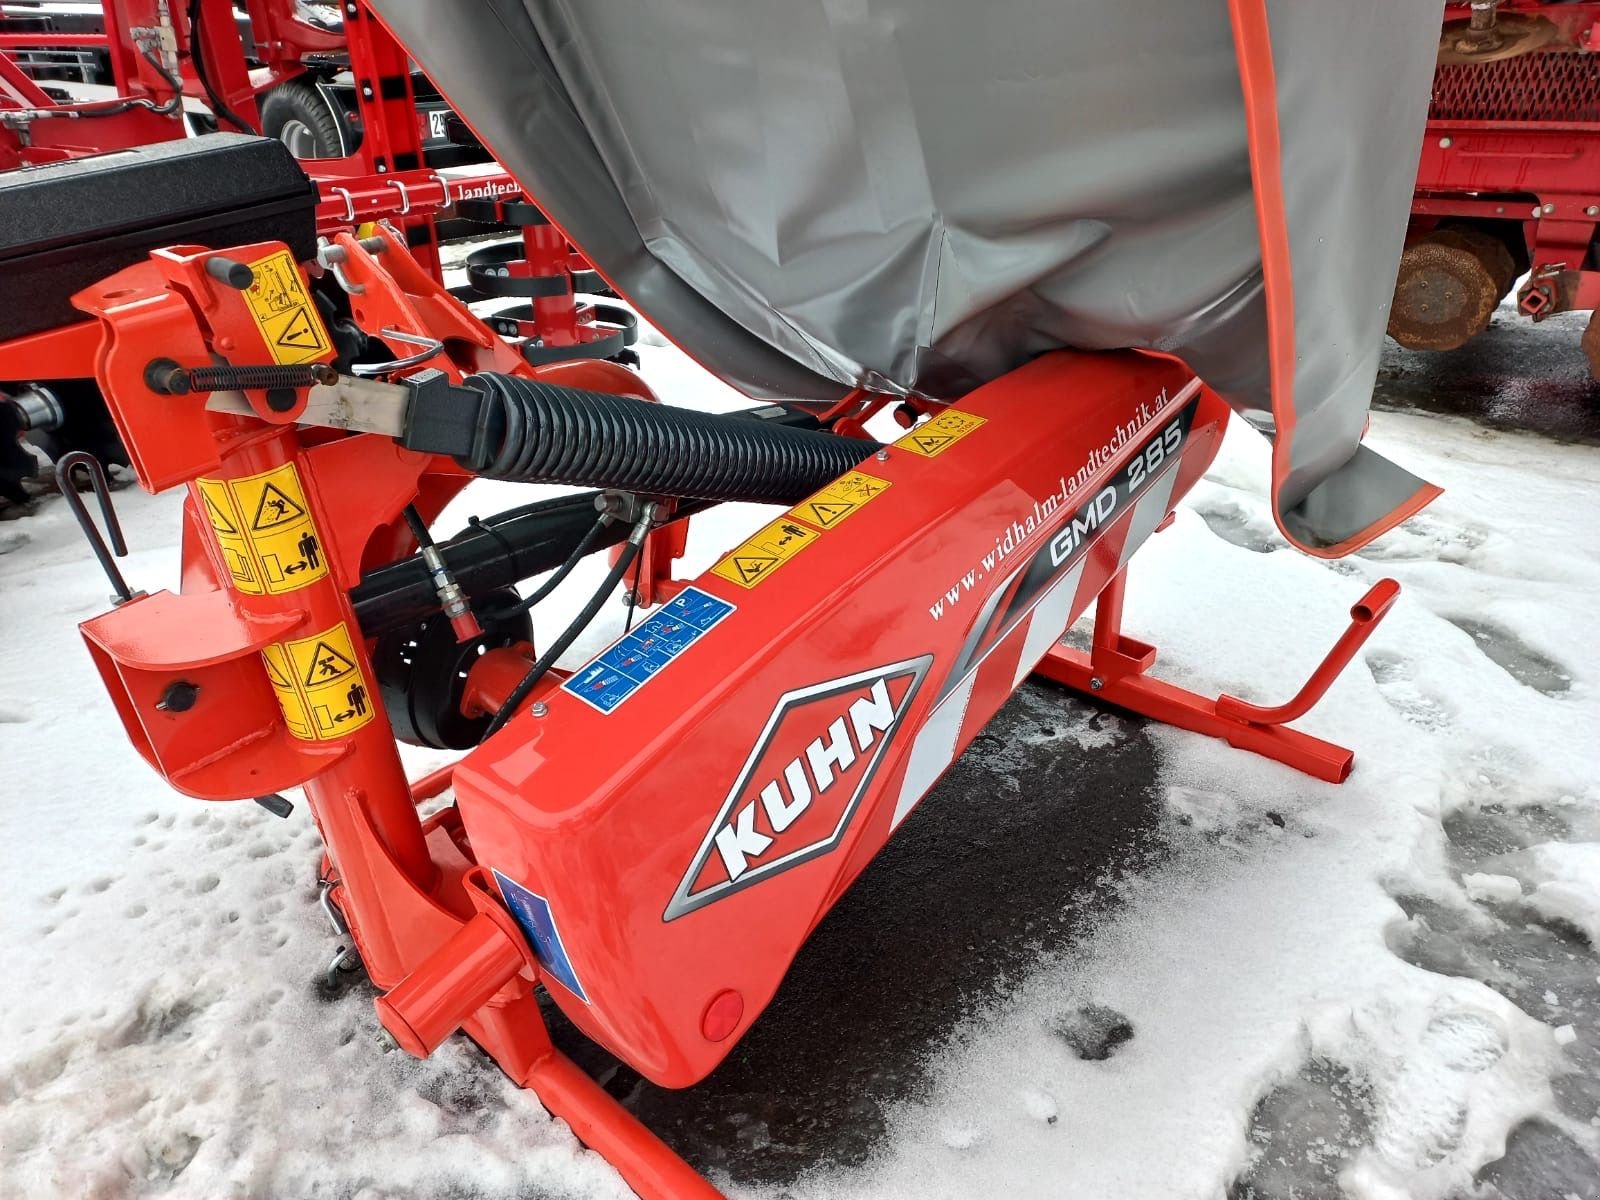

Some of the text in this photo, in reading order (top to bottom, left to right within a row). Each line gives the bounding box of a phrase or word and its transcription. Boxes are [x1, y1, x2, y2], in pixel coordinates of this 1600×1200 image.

[928, 386, 1169, 622] www.widhalm-landtechnik.at
[1050, 418, 1183, 568] GMD 285
[714, 678, 896, 882] KUHN
